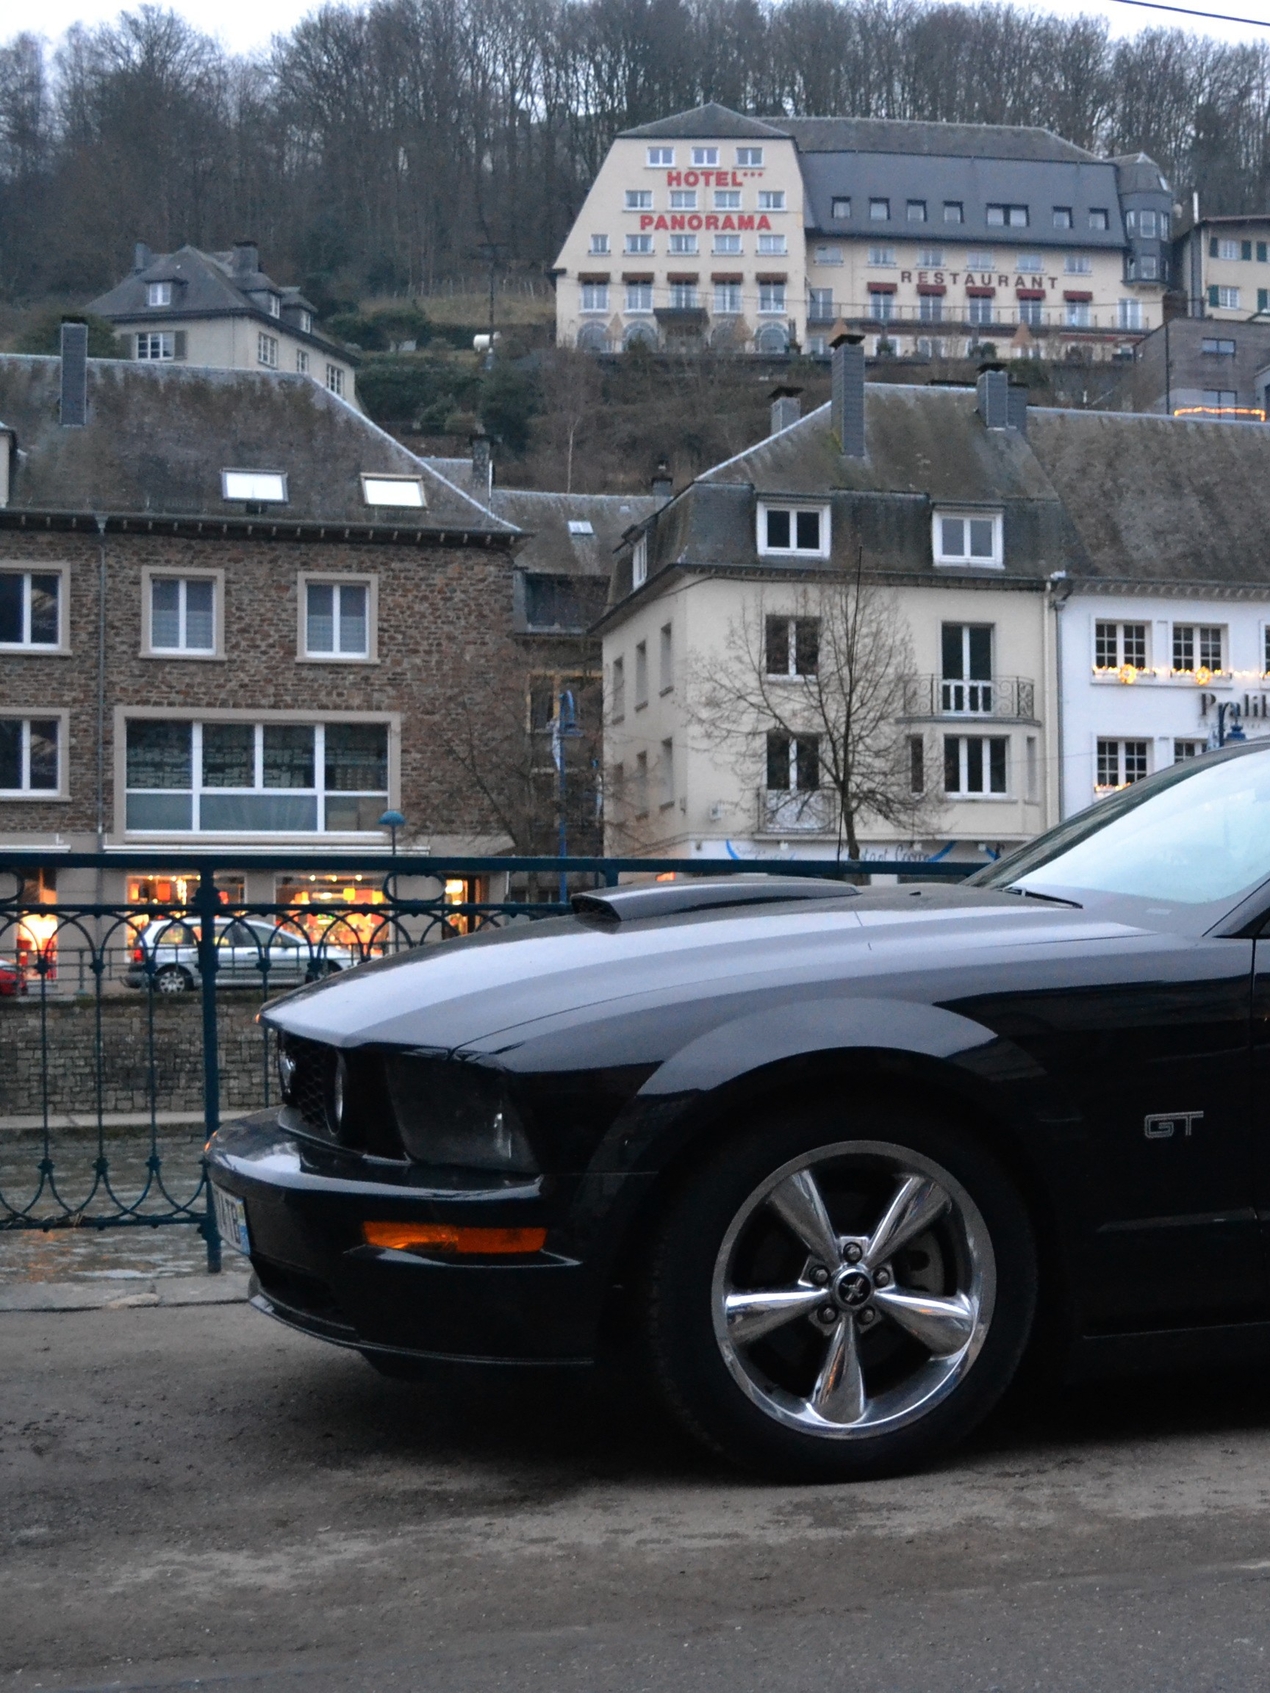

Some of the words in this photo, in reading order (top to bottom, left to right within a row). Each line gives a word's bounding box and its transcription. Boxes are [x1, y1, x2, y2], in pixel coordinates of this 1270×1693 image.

[666, 171, 744, 188] HOTEL
[640, 214, 772, 231] PANORAMA
[900, 271, 1058, 290] RESTAURANT
[1144, 1110, 1204, 1139] GT
